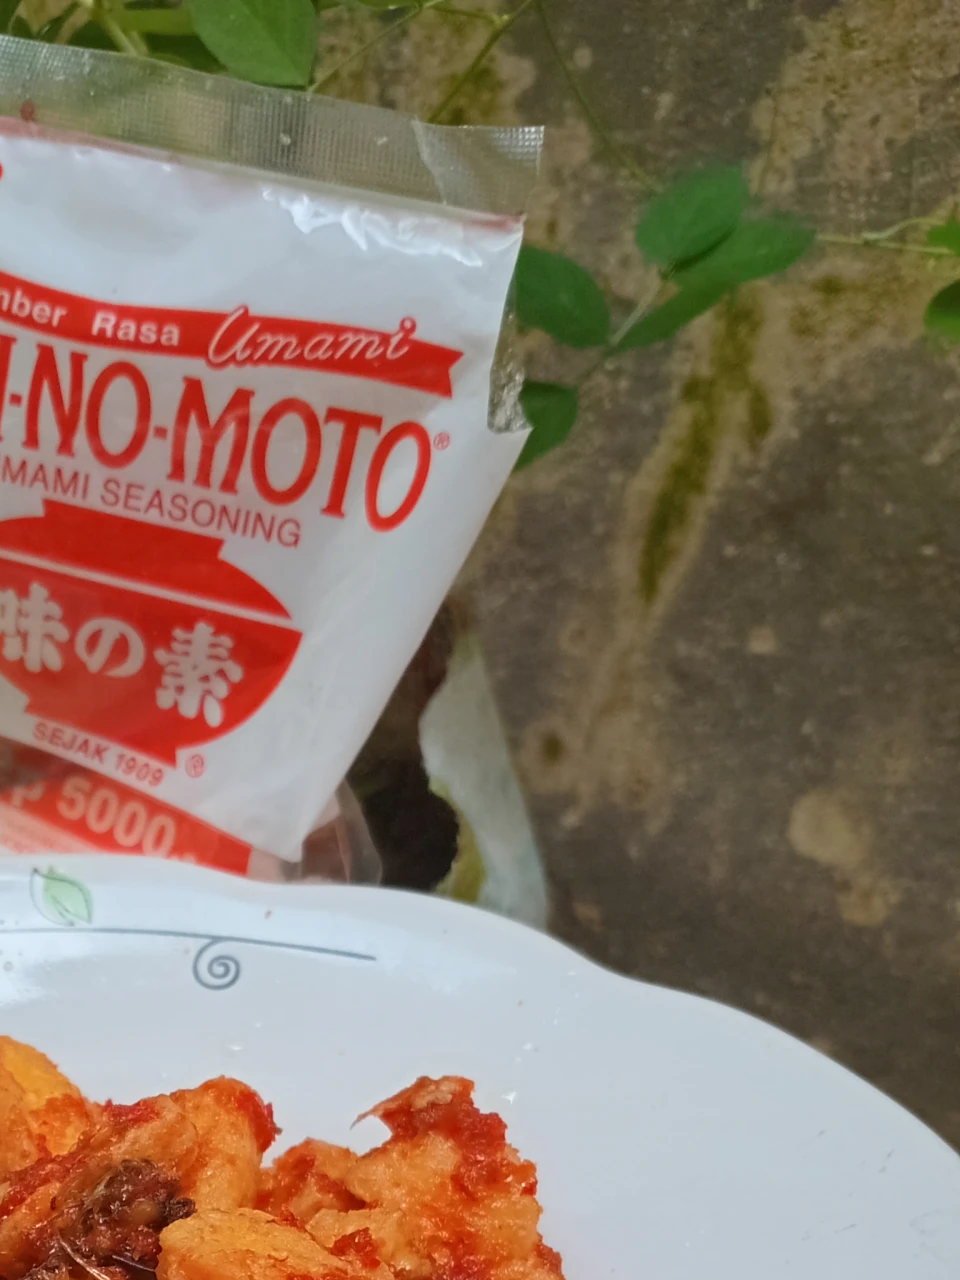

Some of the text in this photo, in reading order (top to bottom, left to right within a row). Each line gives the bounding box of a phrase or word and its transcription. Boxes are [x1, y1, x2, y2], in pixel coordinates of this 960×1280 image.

[91, 309, 180, 346] Rasa
[206, 306, 415, 364] Umami
[100, 478, 302, 549] SEASONING
[33, 721, 165, 787] SEJAK 1909
